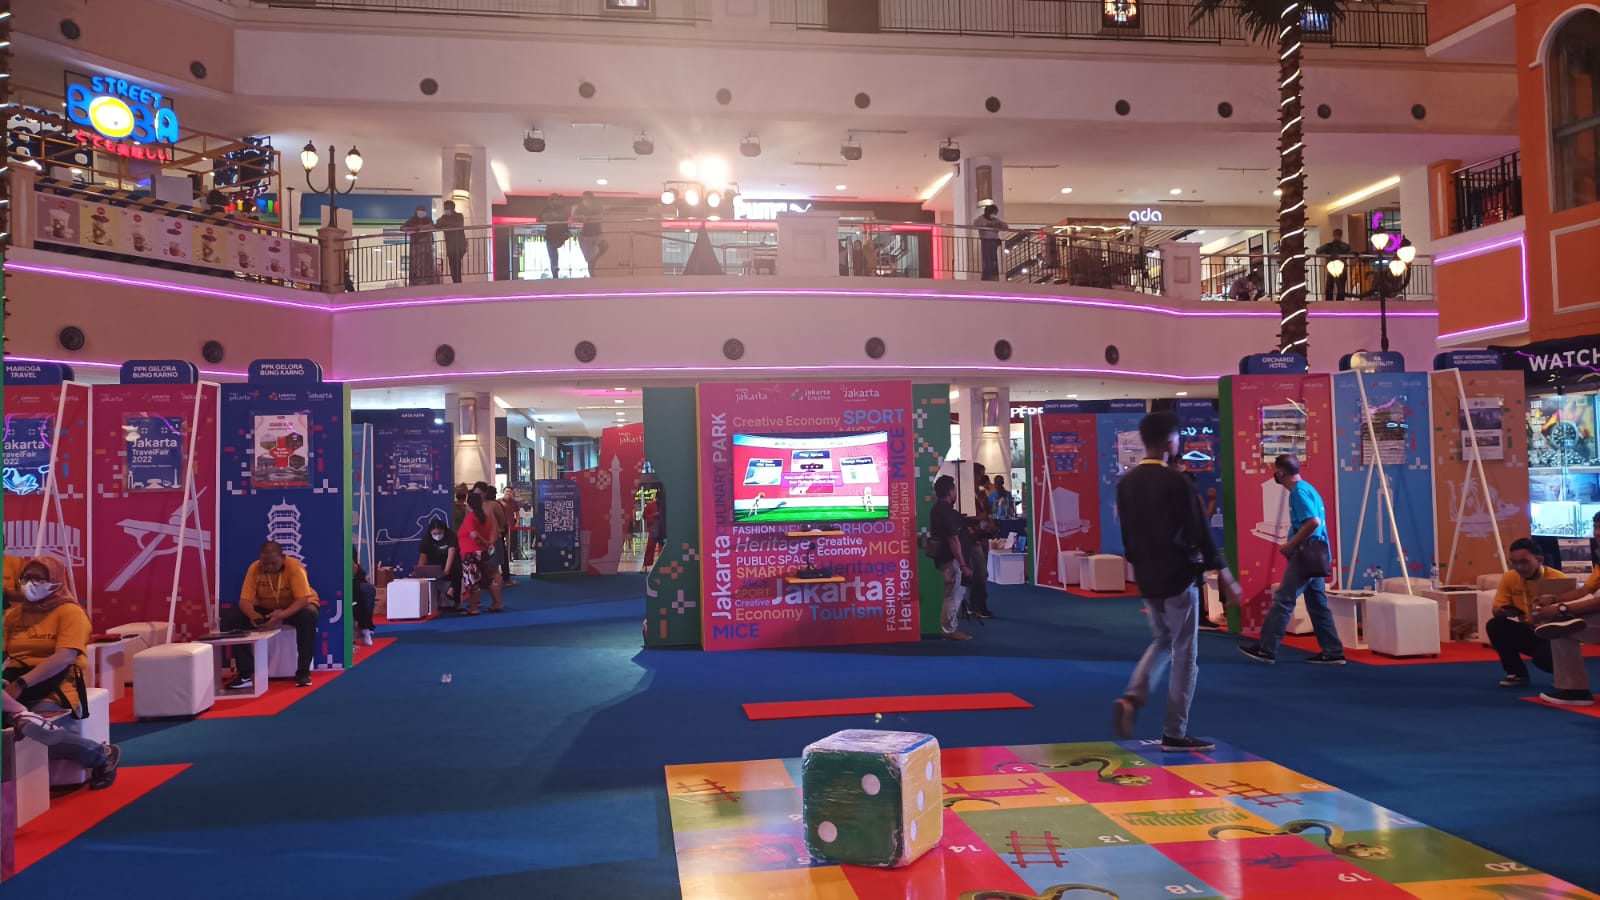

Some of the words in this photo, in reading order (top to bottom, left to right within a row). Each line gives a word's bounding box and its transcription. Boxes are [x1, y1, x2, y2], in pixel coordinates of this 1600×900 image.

[91, 76, 163, 109] STREET
[67, 83, 179, 144] BOBA
[1128, 207, 1162, 222] ada
[732, 416, 783, 428] Creative
[785, 415, 841, 430] Economy
[843, 408, 905, 426] SPORT
[4, 440, 45, 450] akarta
[132, 438, 177, 448] Jakarta
[711, 412, 728, 463] PARK
[2, 450, 37, 458] ravelFair
[889, 427, 907, 479] MICE
[889, 482, 899, 520] Marine
[899, 482, 910, 515] Island
[732, 525, 776, 535] FASHION
[735, 537, 811, 555] Heritage
[817, 536, 863, 546] Creative
[868, 540, 911, 556] MICE
[817, 545, 868, 557] Economy
[736, 555, 776, 567] PUBLIC
[777, 553, 815, 565] SPACE
[736, 565, 785, 579] SMART
[820, 559, 899, 578] Heritage
[711, 535, 733, 620] Jakarta
[771, 575, 883, 606] Jakarta
[898, 558, 914, 631] Heritage
[734, 599, 770, 607] Creative
[885, 577, 896, 632] FASHION
[735, 607, 804, 622] Economy
[809, 603, 883, 622] Tourism
[713, 624, 760, 641] MICE
[1098, 834, 1130, 843] 13
[948, 844, 982, 853] 14
[1484, 861, 1529, 872] 20
[1337, 872, 1373, 883] 19
[1165, 884, 1204, 895] 18
